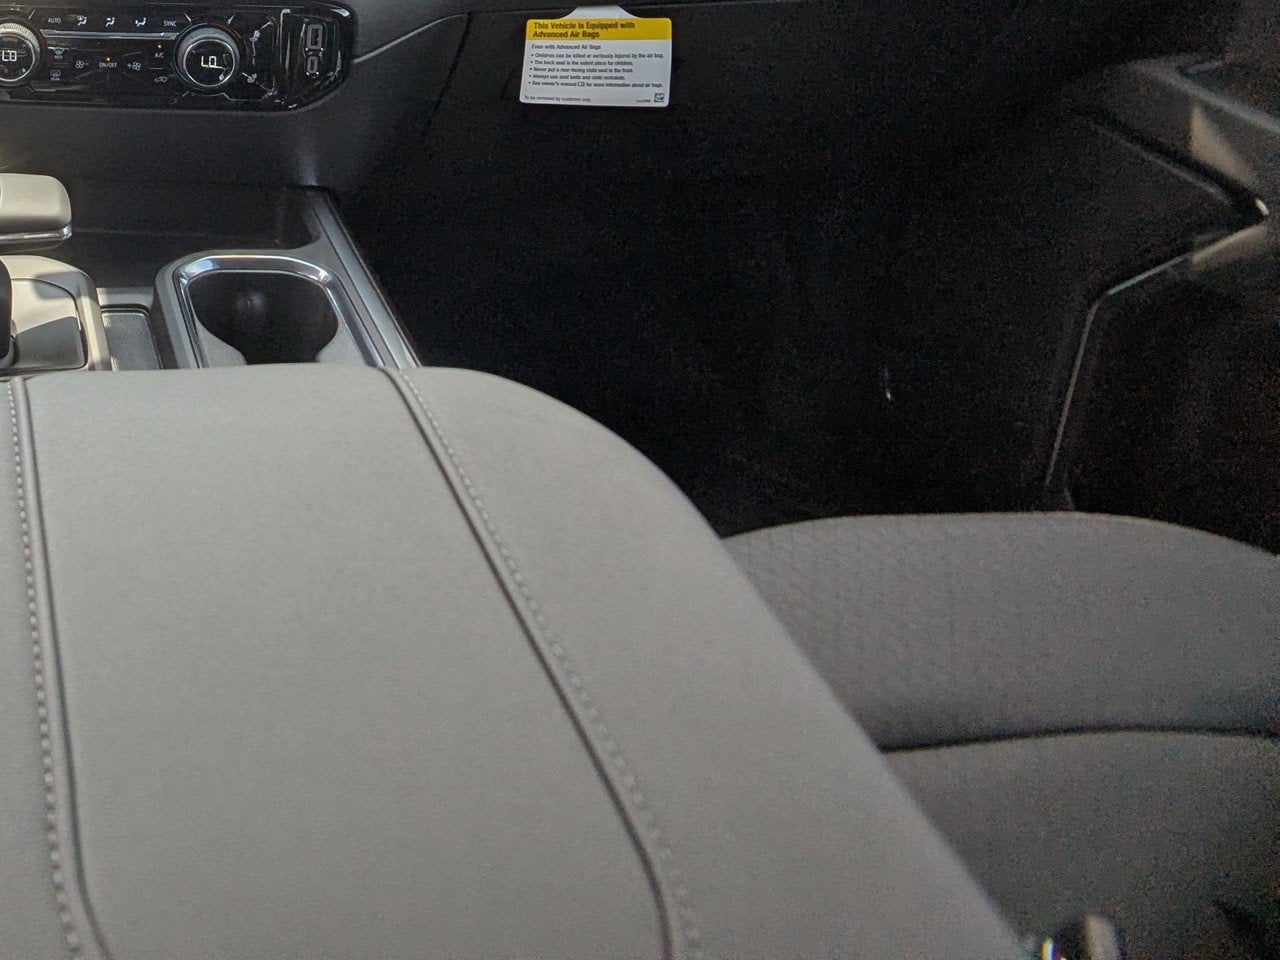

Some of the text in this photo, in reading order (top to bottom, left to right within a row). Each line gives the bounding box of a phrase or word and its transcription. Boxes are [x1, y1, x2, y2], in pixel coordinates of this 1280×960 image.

[47, 17, 62, 25] AUTO
[534, 21, 636, 30] This Vehicle is Equipped with
[532, 30, 600, 39] Advanced Air Bags
